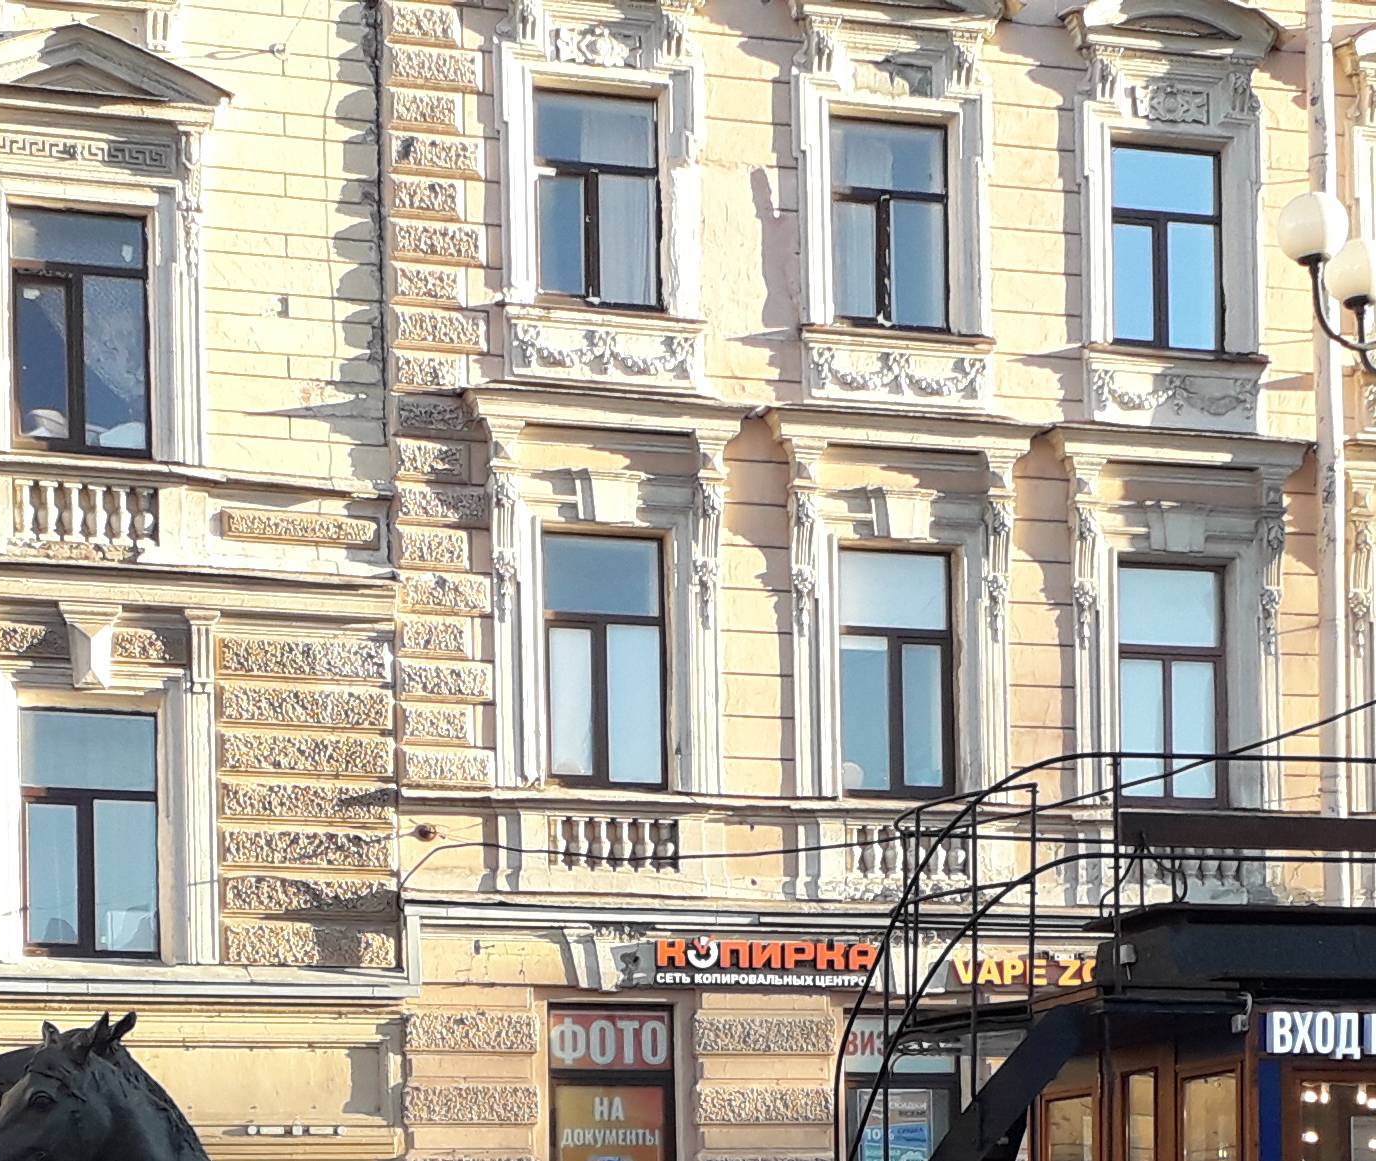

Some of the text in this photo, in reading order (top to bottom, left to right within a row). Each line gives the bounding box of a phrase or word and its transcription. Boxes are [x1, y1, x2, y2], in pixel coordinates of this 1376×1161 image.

[655, 935, 876, 970] КОПИРКА
[656, 972, 691, 984] СЕТЬ
[694, 973, 814, 986] КОПИРОВАЛЬНЫХ
[953, 960, 1048, 985] VAPE
[550, 1018, 667, 1066] ФОТО
[1267, 1010, 1362, 1059] ВХОД
[593, 1096, 625, 1122] НА
[561, 1126, 660, 1149] ДОКУМЕНТЫ
